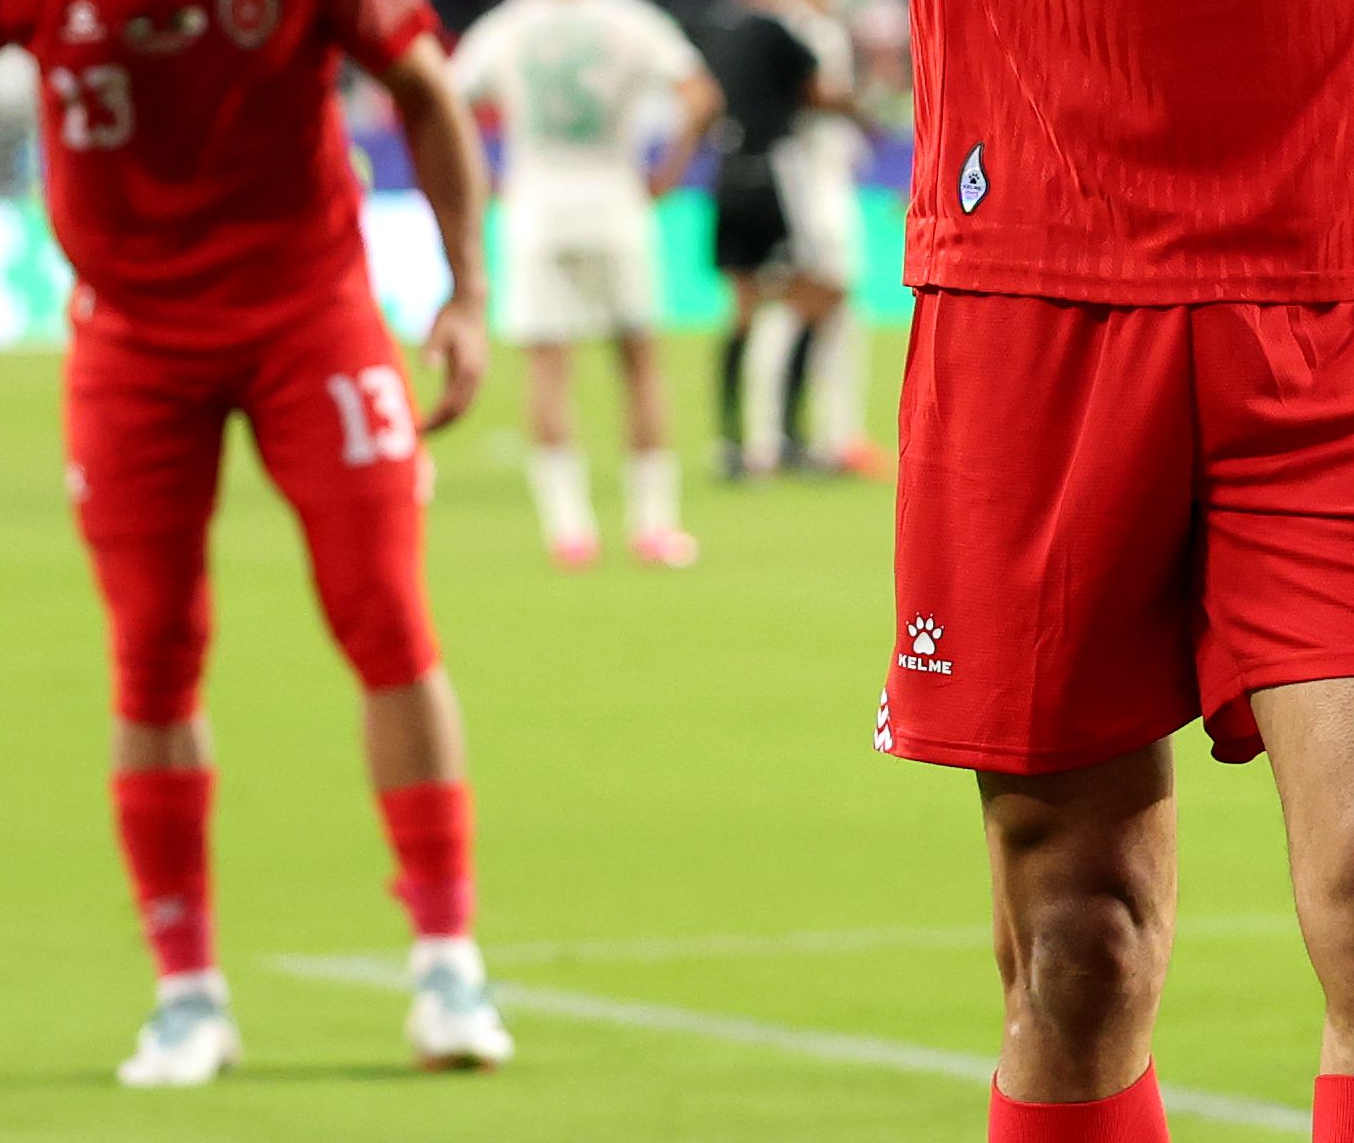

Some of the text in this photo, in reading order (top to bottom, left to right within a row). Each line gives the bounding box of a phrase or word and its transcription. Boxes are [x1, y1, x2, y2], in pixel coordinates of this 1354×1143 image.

[48, 65, 134, 153] 13
[327, 364, 415, 467] 13
[898, 654, 952, 675] KELME
